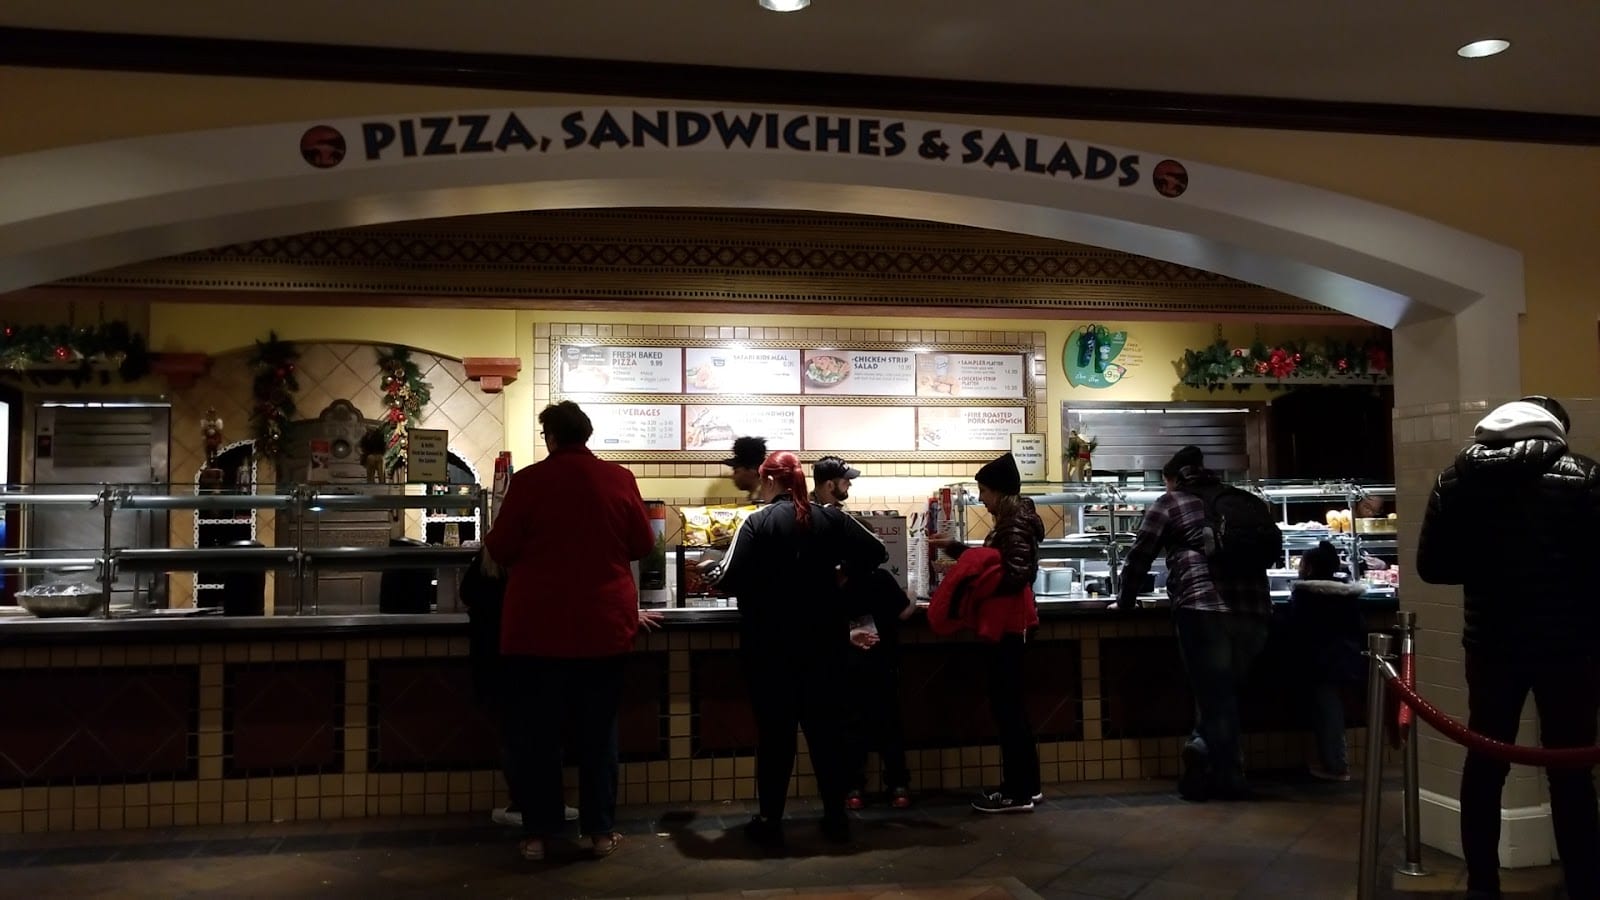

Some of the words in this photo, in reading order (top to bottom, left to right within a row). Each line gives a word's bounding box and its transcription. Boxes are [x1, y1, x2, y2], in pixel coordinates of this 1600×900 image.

[362, 112, 551, 160] PIZZA,
[562, 109, 906, 157] SANDWICHES
[918, 130, 949, 161] &
[961, 130, 1140, 187] SALADS
[612, 351, 637, 359] FRESH
[638, 351, 663, 359] BAKED
[854, 355, 886, 363] CHICKEN
[612, 408, 661, 416] VERAGES
